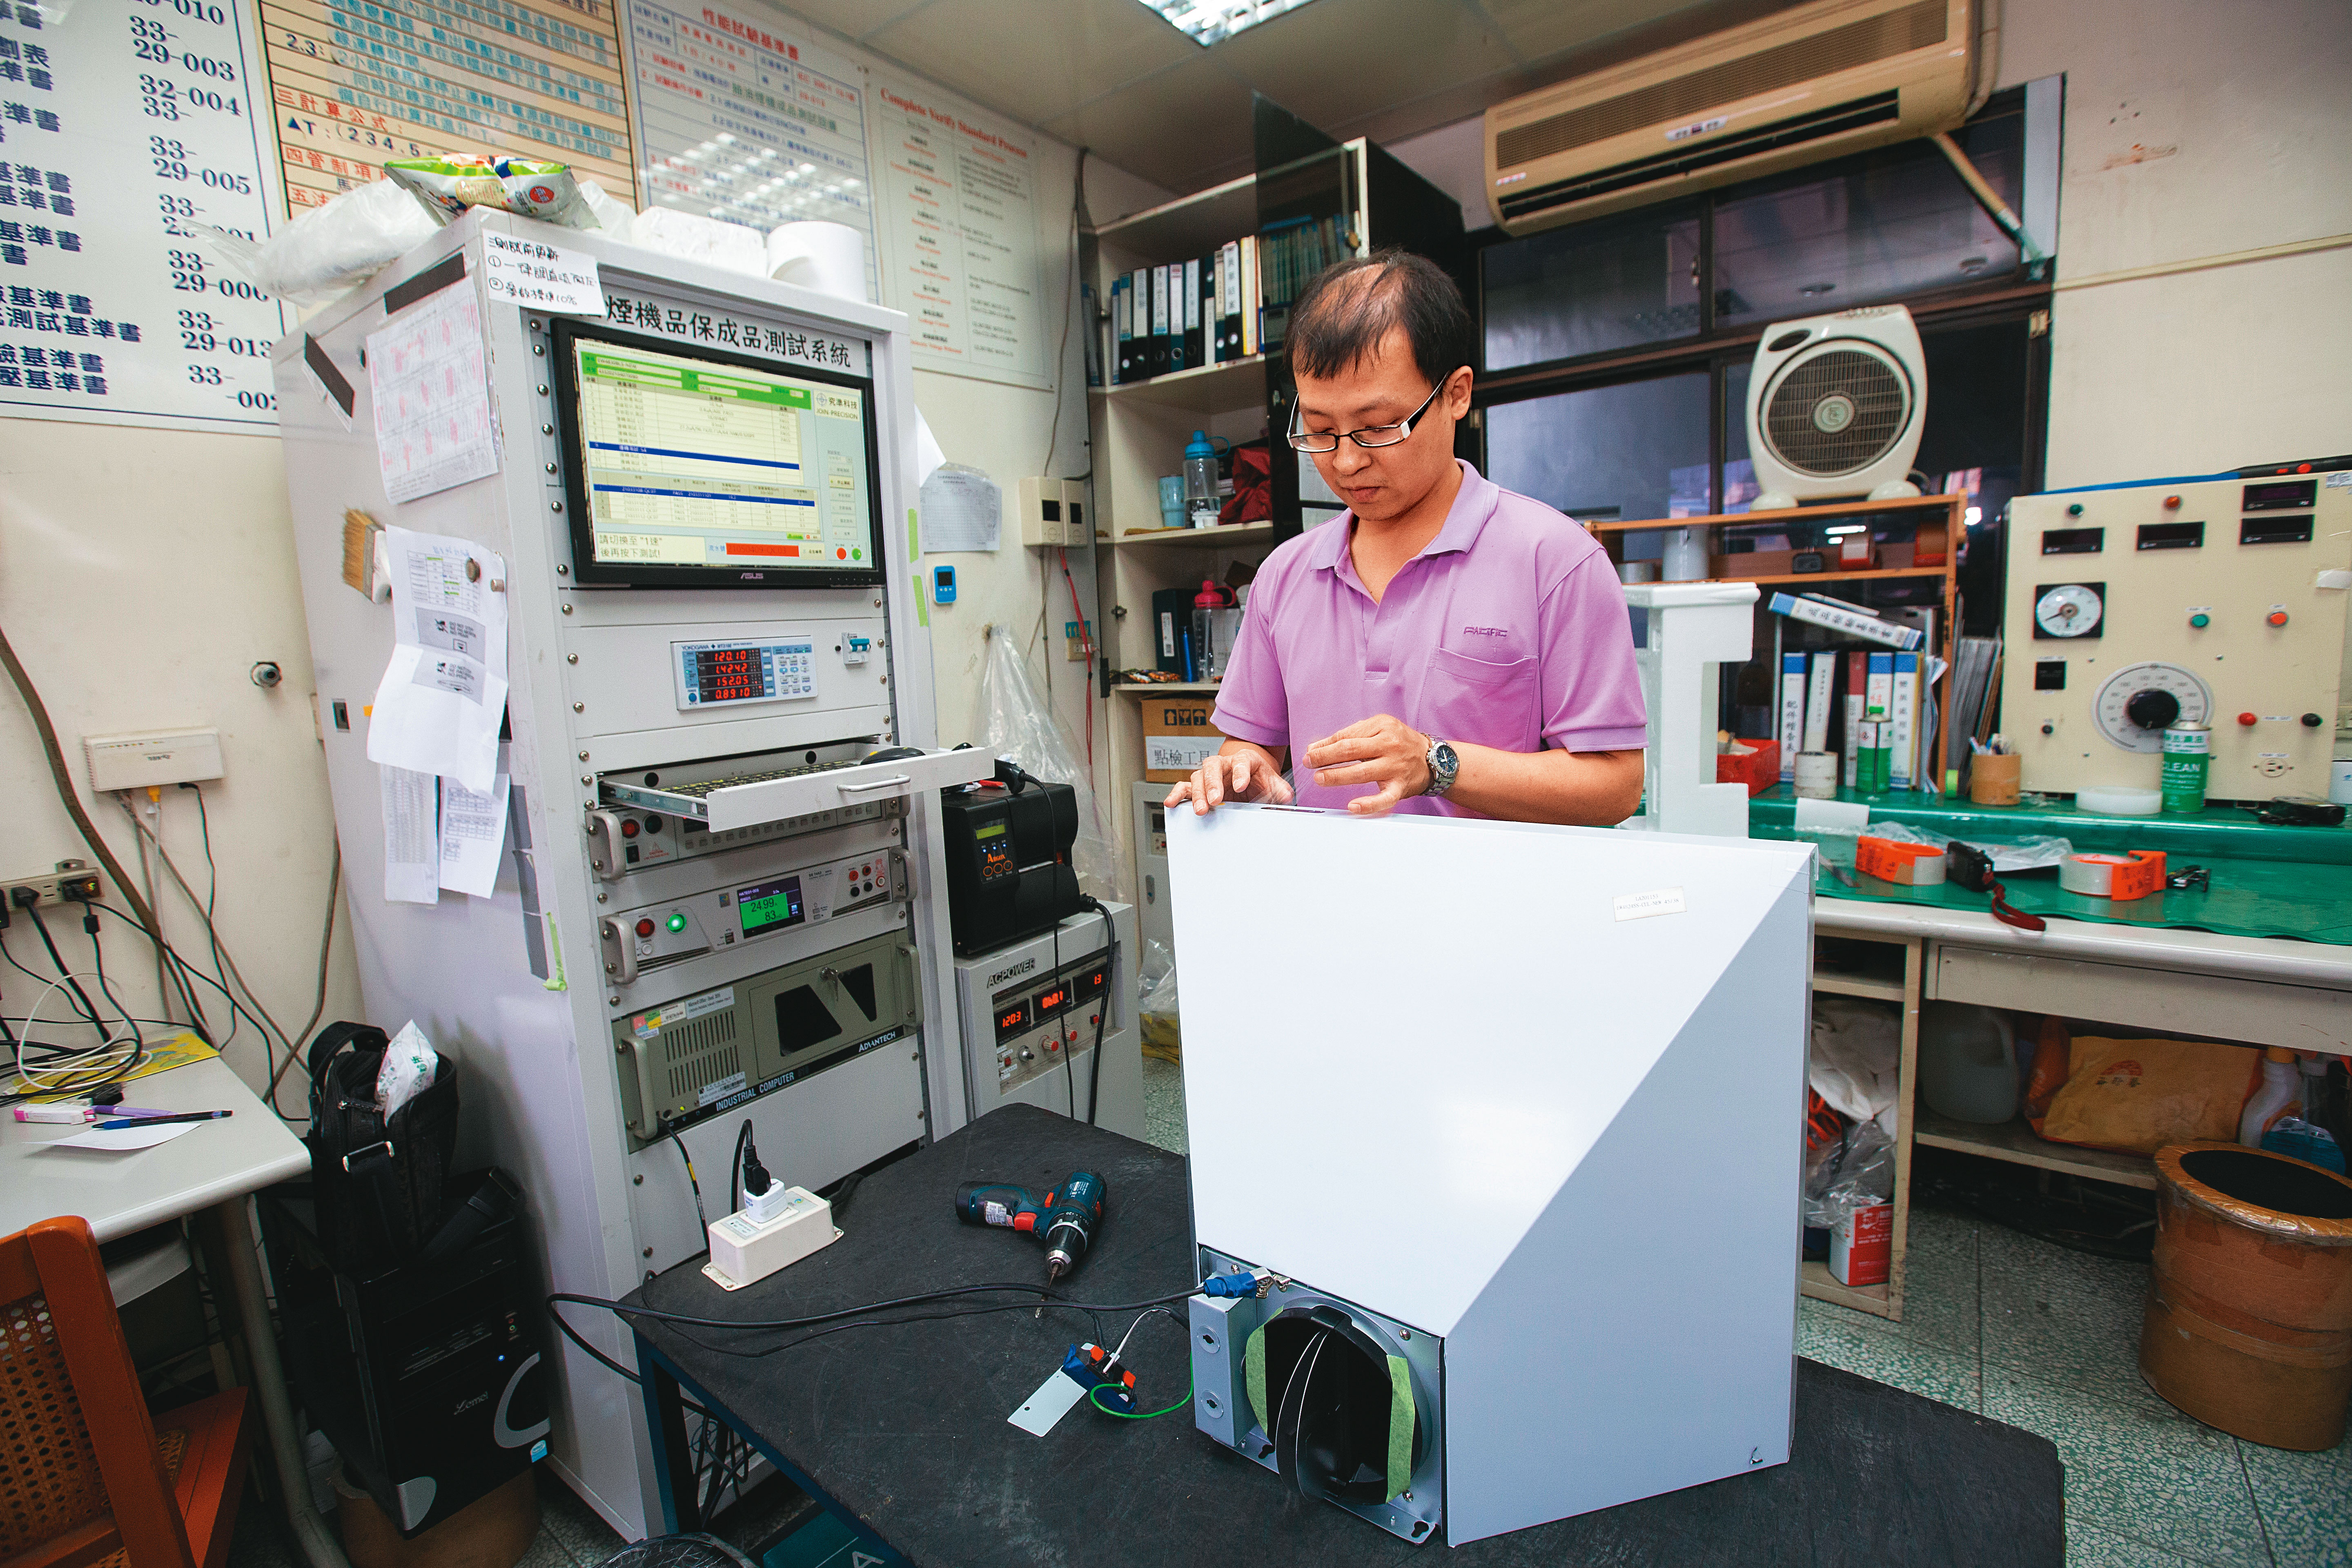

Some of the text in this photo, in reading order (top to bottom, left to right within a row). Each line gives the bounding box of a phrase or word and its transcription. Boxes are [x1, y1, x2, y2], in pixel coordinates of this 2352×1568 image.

[135, 0, 225, 25] -010
[129, 16, 180, 42] 33-
[134, 39, 236, 82] 29-003
[139, 74, 242, 117] 32-004
[143, 96, 192, 122] 33-
[880, 87, 927, 117] Complete
[958, 120, 997, 146] Standard
[149, 135, 198, 160] 33-
[153, 158, 252, 195] 29-005
[159, 194, 206, 218] 33-
[0, 219, 83, 252] 基準書
[1, 243, 29, 265] 書
[168, 249, 215, 272] 33-
[0, 285, 94, 315] 基準書
[0, 305, 143, 343] 測試基準書
[178, 309, 225, 332] 33-
[180, 331, 272, 359] 29-013
[188, 365, 235, 386] 33-
[831, 410, 858, 419] PRECISION
[600, 547, 661, 558] 後再按下測試!
[1463, 626, 1508, 637] PACIFIC
[717, 675, 748, 686] 152.05
[751, 898, 775, 913] 24.99
[765, 910, 776, 922] 83
[858, 1031, 896, 1053] ADVANTECH
[716, 1087, 757, 1111] INDUSTRIAL
[759, 1071, 795, 1094] COMPUTER
